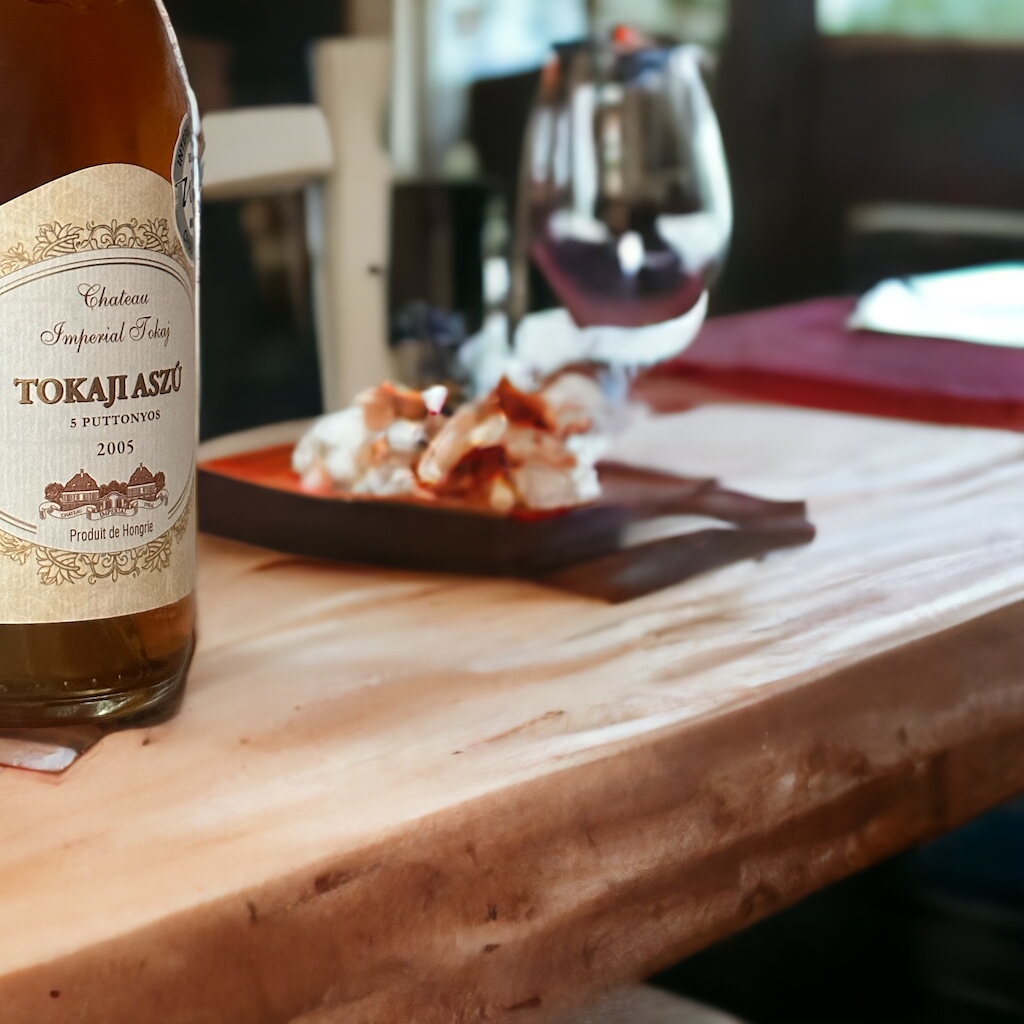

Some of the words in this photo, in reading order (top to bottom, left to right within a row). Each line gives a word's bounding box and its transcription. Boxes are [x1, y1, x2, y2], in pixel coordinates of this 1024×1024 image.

[77, 282, 150, 310] Chateau
[40, 321, 125, 353] Imperial
[128, 316, 171, 347] Tokaj
[13, 375, 128, 408] TOKAJI
[130, 360, 183, 399] ASZÚ
[70, 418, 77, 428] 5
[82, 409, 161, 427] PUTTONYOS
[97, 439, 134, 456] 2005
[70, 528, 106, 542] Produit
[109, 527, 120, 538] de
[123, 520, 154, 539] Hongrie
